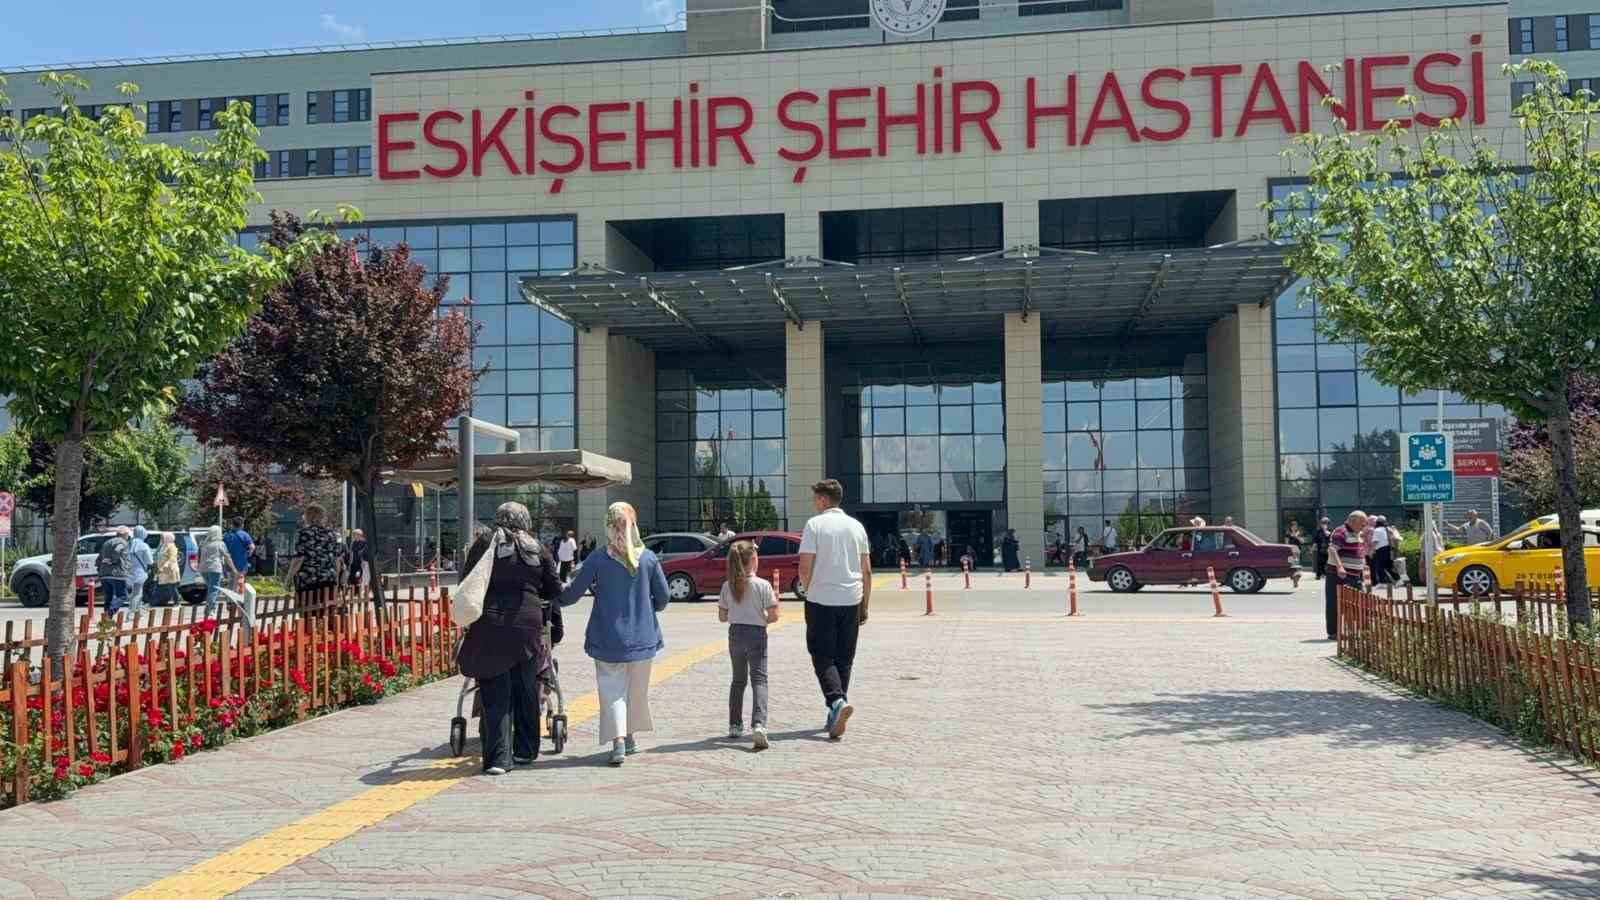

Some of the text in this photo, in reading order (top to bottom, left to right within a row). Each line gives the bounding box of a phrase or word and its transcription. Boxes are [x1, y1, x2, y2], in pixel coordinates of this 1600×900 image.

[377, 33, 1487, 194] ESKİŞEHİR ŞEHİR HASTANESİ
